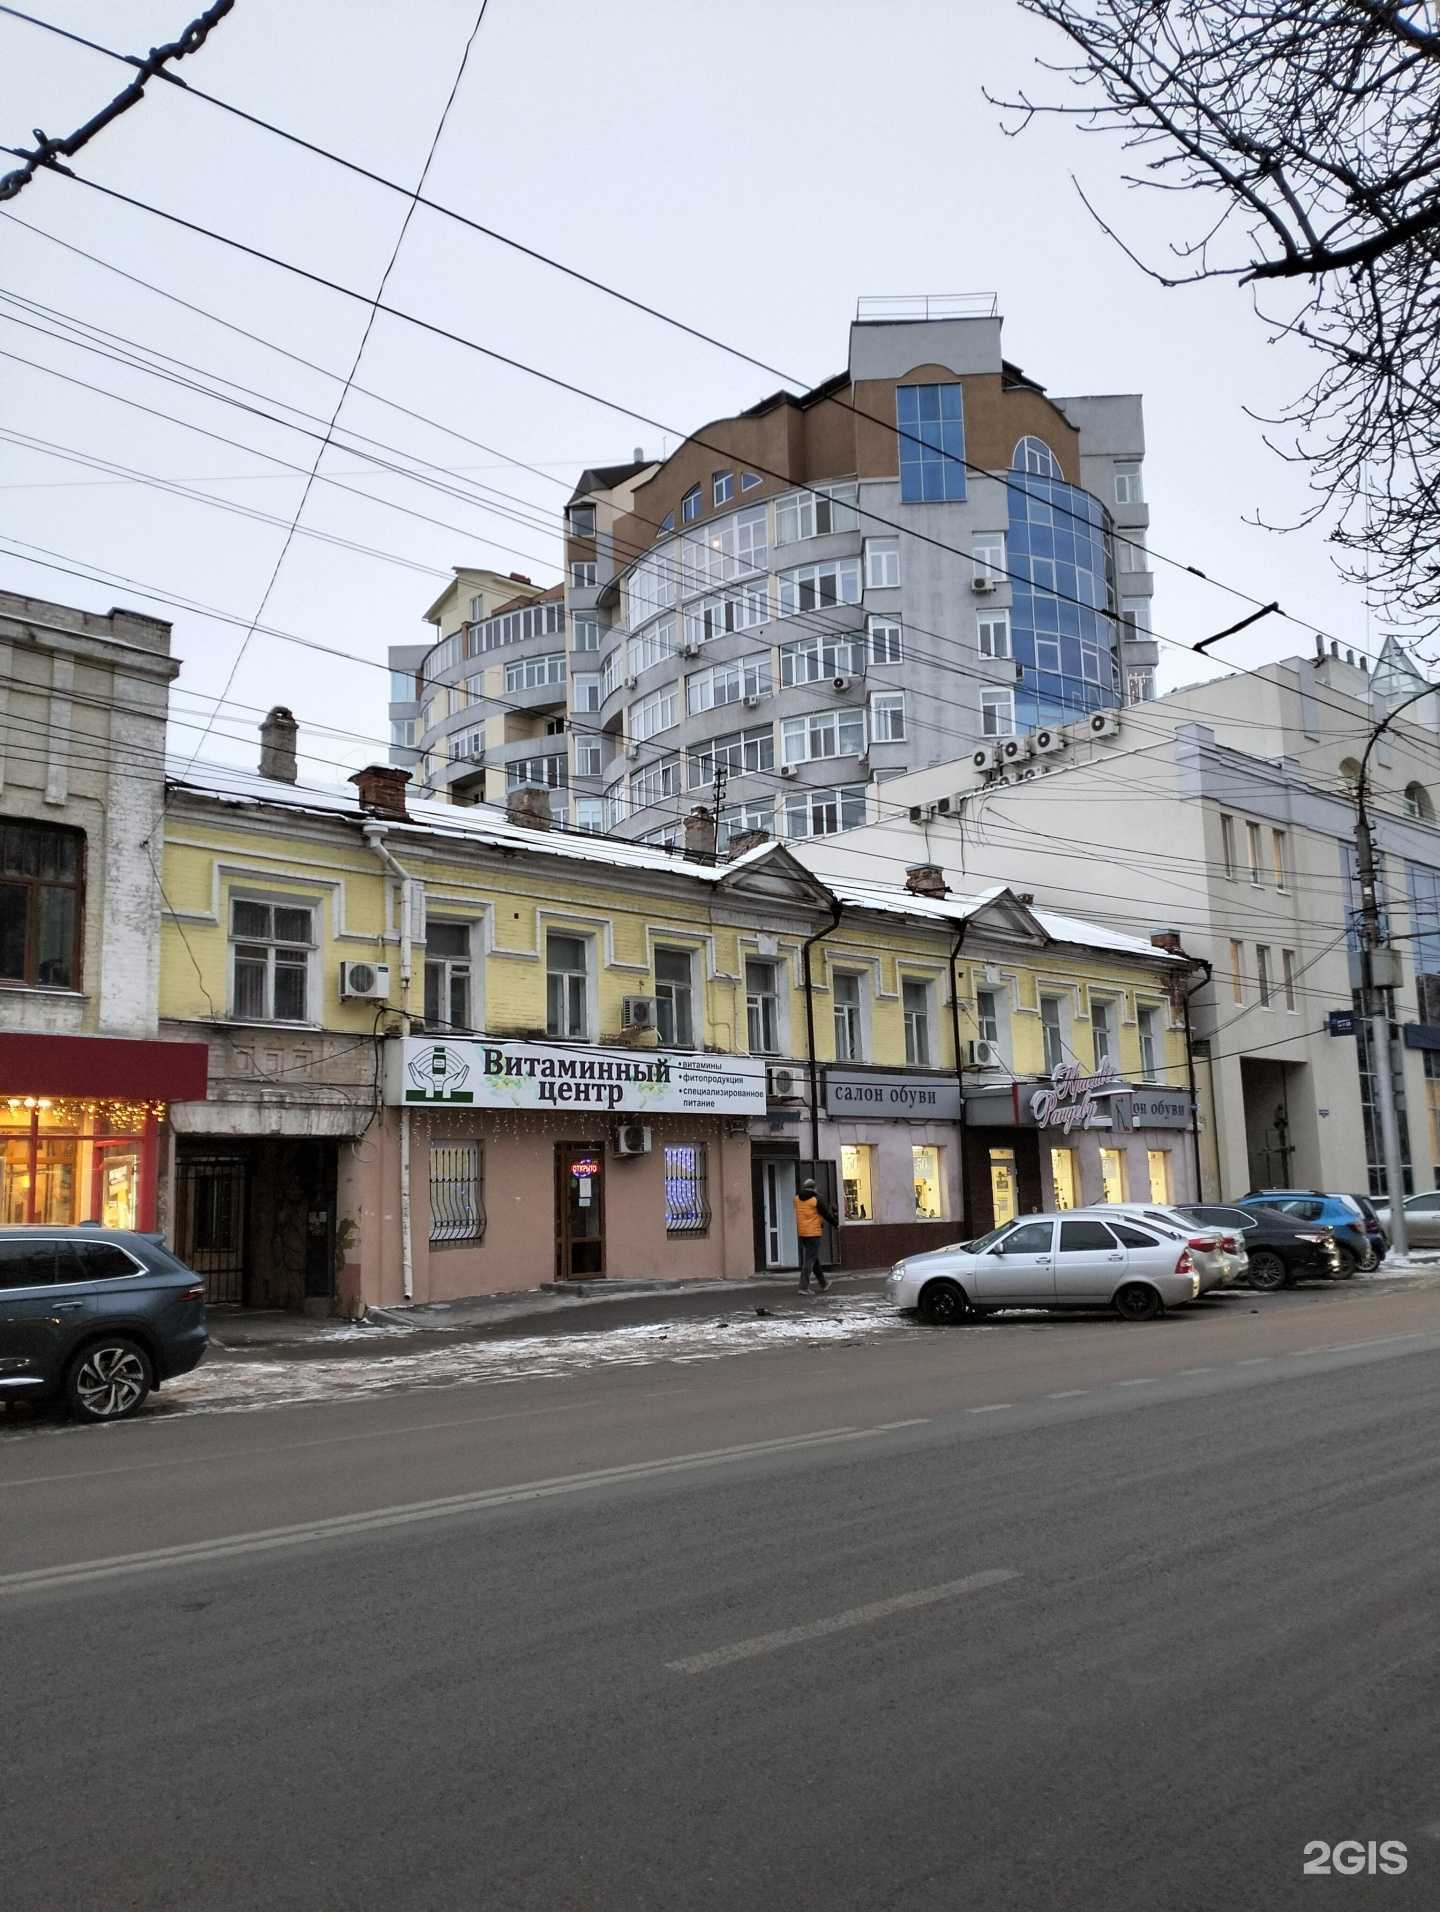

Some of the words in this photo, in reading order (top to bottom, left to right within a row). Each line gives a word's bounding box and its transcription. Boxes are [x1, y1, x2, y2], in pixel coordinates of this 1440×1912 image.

[483, 1048, 671, 1083] Витаминный
[682, 1061, 722, 1070] витамины
[682, 1073, 744, 1085] фитопродукция
[538, 1080, 624, 1109] центр
[683, 1087, 764, 1099] специализированное
[835, 1085, 883, 1102] салон
[890, 1085, 936, 1108] обуви
[683, 1099, 716, 1108] питание
[1151, 1100, 1185, 1119] обуви
